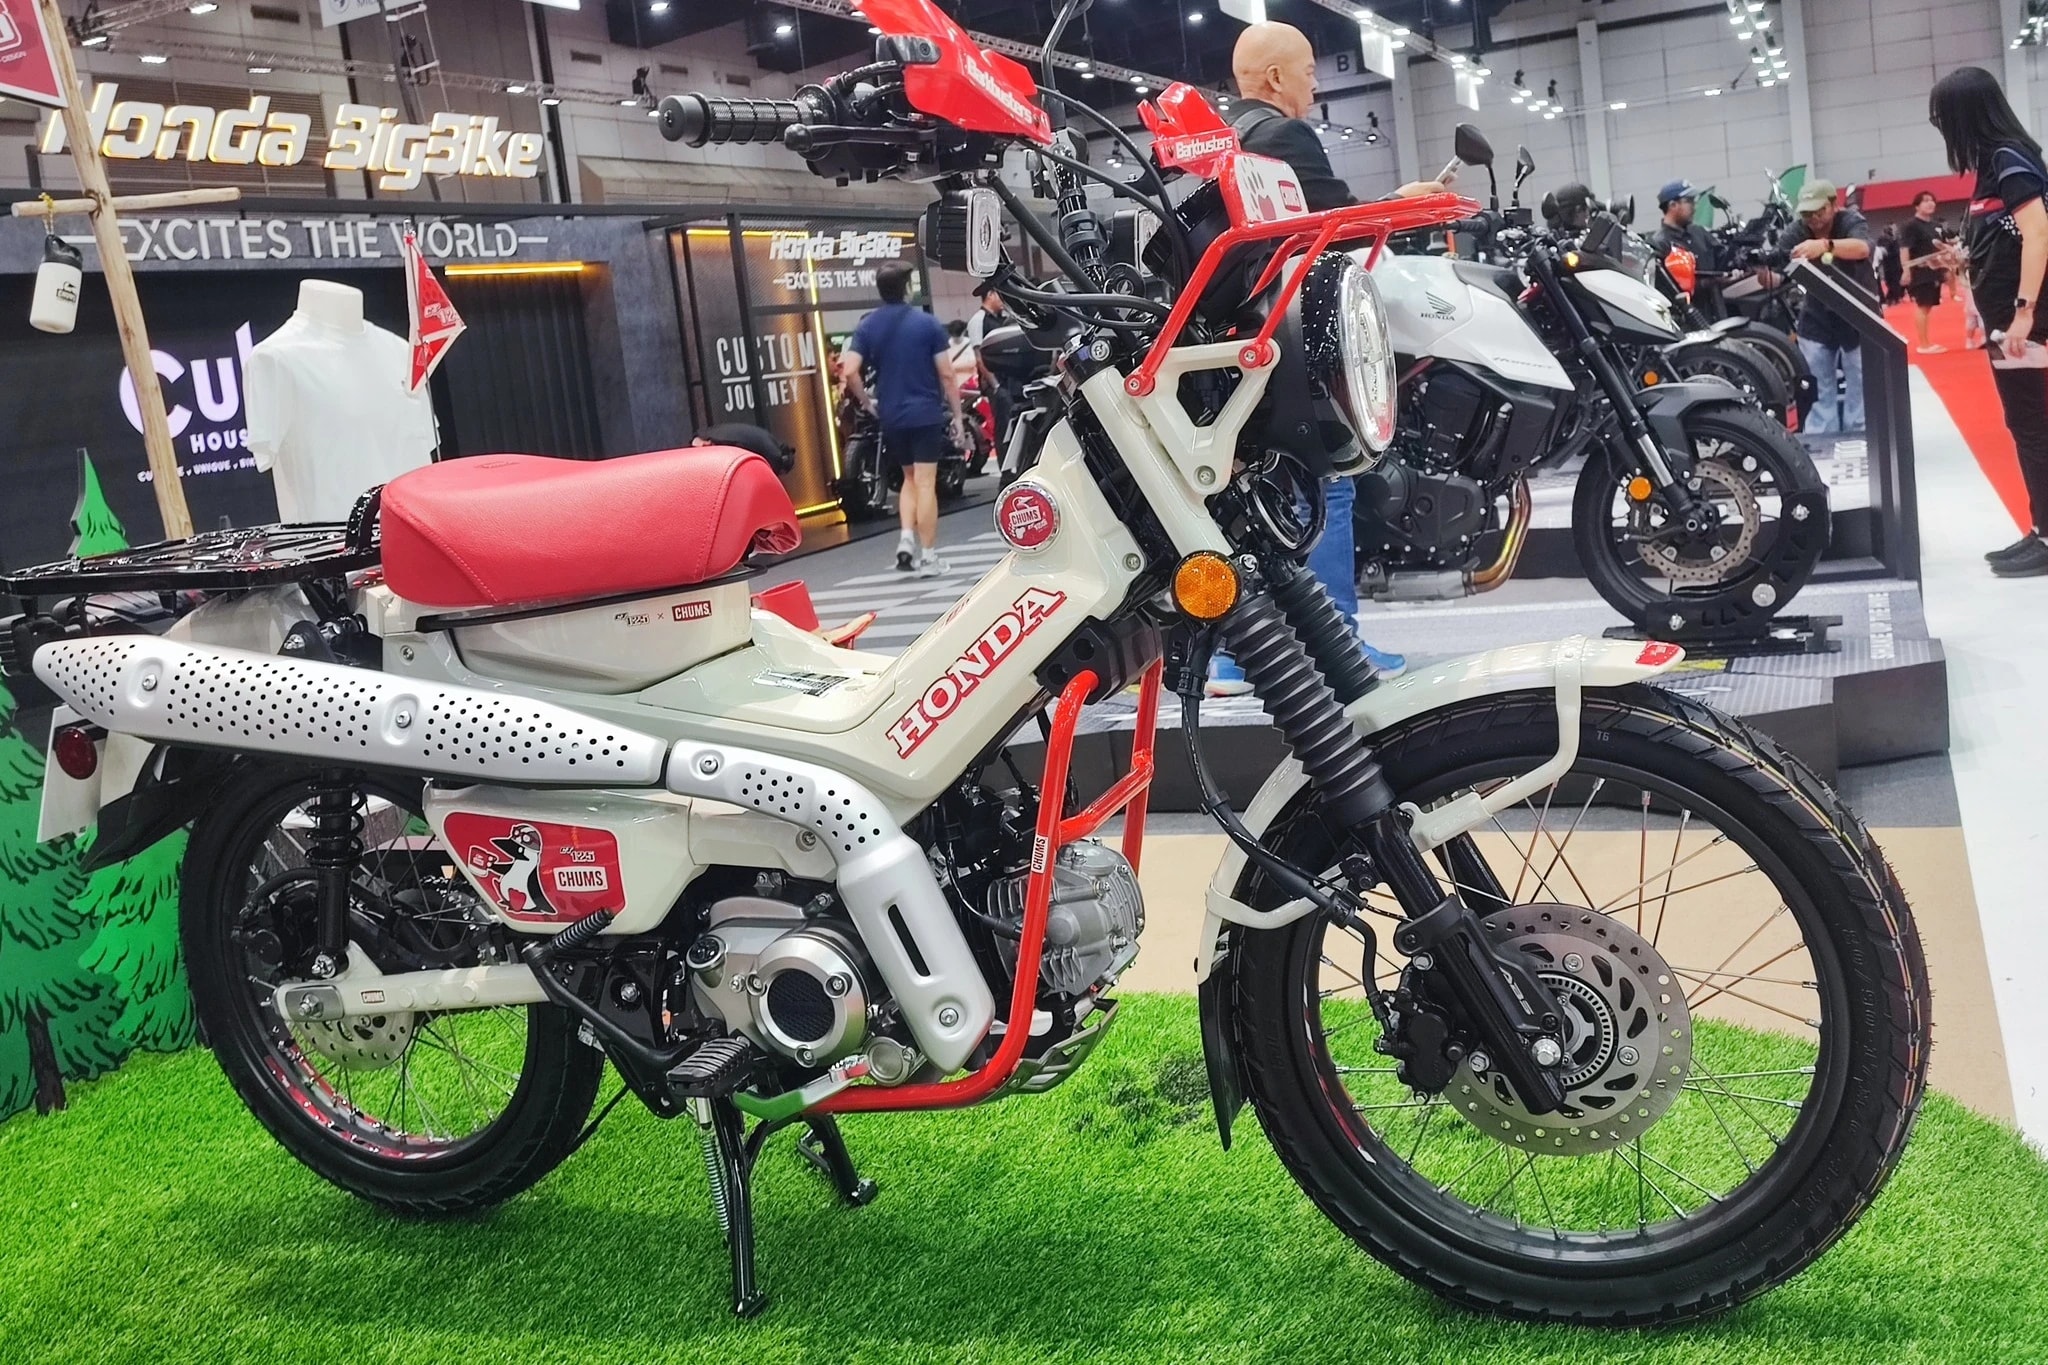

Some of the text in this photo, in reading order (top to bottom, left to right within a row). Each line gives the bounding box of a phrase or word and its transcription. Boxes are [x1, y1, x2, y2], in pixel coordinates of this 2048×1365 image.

[1337, 54, 1350, 72] B
[966, 54, 1033, 125] Barkbusters
[41, 81, 544, 191] Honda BigBike
[1175, 134, 1234, 160] Barkbusters
[1868, 169, 1877, 180] F
[301, 219, 383, 259] THE
[769, 230, 902, 267] Honda BigBike
[834, 270, 858, 288] THE
[1420, 312, 1455, 321] HONDA
[724, 378, 799, 412] JOUNEY
[190, 428, 248, 454] HOUS
[192, 460, 231, 475] UNIQUE
[1011, 508, 1040, 526] CHUMS
[674, 603, 711, 620] CHUMS
[886, 587, 1067, 760] HONDA
[1032, 836, 1046, 871] CHUMS
[558, 869, 605, 888] CHUMS
